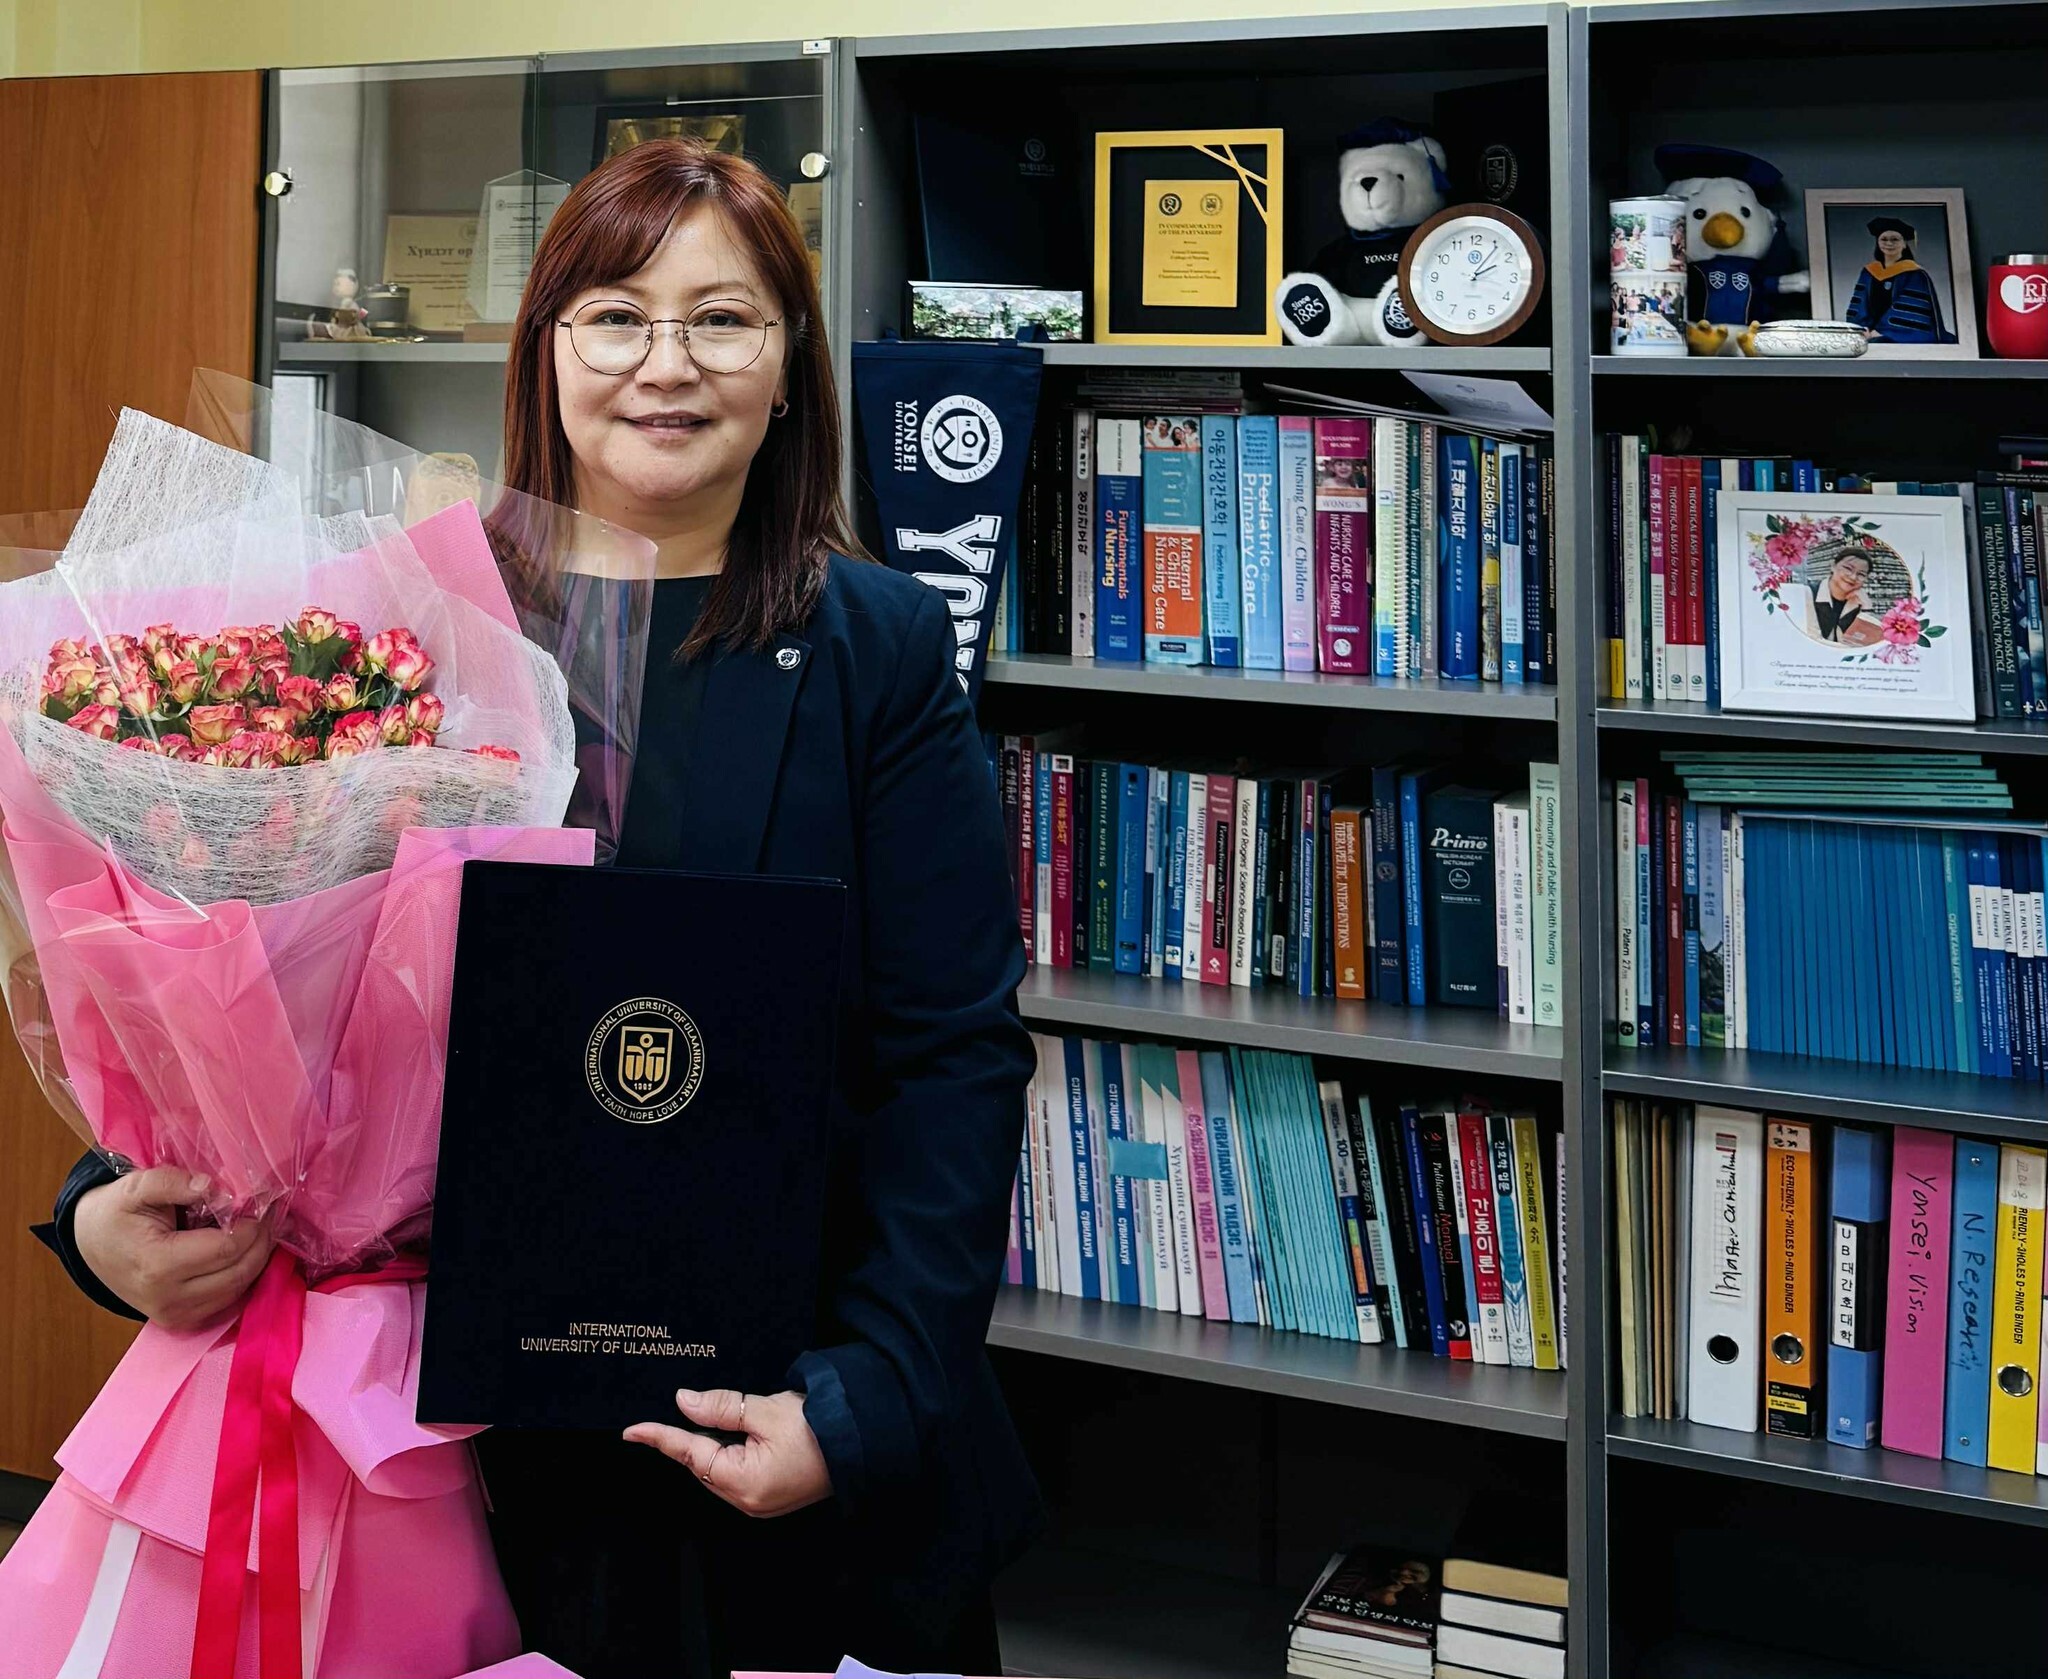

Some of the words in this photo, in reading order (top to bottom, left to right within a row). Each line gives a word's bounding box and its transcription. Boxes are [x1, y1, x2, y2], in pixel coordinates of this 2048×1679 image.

[1452, 240, 1462, 250] 11
[1470, 235, 1482, 246] 12
[1364, 253, 1398, 264] YONSE
[1438, 254, 1449, 265] 10
[1504, 253, 1512, 263] 2
[1430, 272, 1438, 282] 9
[1510, 274, 1518, 284] 3
[1291, 296, 1311, 311] Since
[1293, 298, 1324, 325] 1885
[1436, 291, 1444, 301] 8
[1450, 304, 1458, 314] 7
[1488, 305, 1495, 315] 5
[1503, 291, 1510, 301] 4
[1468, 310, 1476, 320] 6
[894, 401, 903, 472] UNIVERSITY
[904, 400, 918, 472] YONSEI
[1294, 456, 1308, 502] Nursing
[1105, 510, 1114, 524] of
[1242, 473, 1256, 560] Primary
[1258, 473, 1272, 567] Pediatric
[1295, 506, 1308, 534] Care
[1409, 488, 1419, 525] Writing
[1651, 474, 1662, 558] 간호연구방법
[1668, 486, 1677, 532] THEORETICAL
[1688, 486, 1696, 532] THEORETICAL
[1168, 537, 1180, 548] &
[1330, 514, 1340, 550] INFANTS
[1340, 514, 1352, 553] NURSING
[1670, 533, 1678, 554] BASIS
[1689, 533, 1697, 554] BASIS
[1994, 524, 2006, 557] HEALTH
[1102, 528, 1117, 586] Nursing
[1118, 510, 1129, 600] Fundamentals
[1152, 536, 1167, 594] Nursing
[1330, 552, 1340, 573] AND
[1410, 528, 1419, 574] Literature
[1670, 556, 1679, 568] for
[1690, 556, 1698, 568] for
[1984, 526, 1996, 578] PREVENTION
[2021, 525, 2036, 575] SOCIOLOGY
[1168, 551, 1180, 588] Child
[1182, 537, 1194, 601] Maternal
[1295, 547, 1308, 602] Children
[1341, 556, 1352, 578] CARE
[1668, 568, 1680, 597] Nursing
[1688, 568, 1698, 597] Nursing
[1244, 564, 1258, 615] Care
[1330, 574, 1340, 618] CHILDREN
[1342, 580, 1352, 593] OF
[1410, 578, 1420, 616] Reviews
[1988, 580, 1997, 590] IN
[1997, 560, 2008, 612] PROMOTION
[1155, 597, 1168, 630] Care
[1990, 592, 2002, 631] CLINICAL
[2000, 617, 2012, 638] AND
[1994, 633, 2006, 673] PRACTICE
[2004, 638, 2016, 674] DISEASE
[1100, 768, 1108, 824] INTEGRATIVE
[1242, 798, 1251, 826] Visions
[1188, 828, 1196, 848] FOR
[1197, 808, 1206, 842] MIDDLE
[1346, 822, 1354, 854] Handbook
[1546, 796, 1556, 848] Community
[1098, 828, 1107, 867] NURSING
[1176, 826, 1186, 852] Clinical
[1218, 825, 1228, 872] Perspectives
[1334, 822, 1347, 880] THERAPEUTIC
[1430, 827, 1488, 850] Prime
[1174, 854, 1184, 883] Decision
[1188, 850, 1196, 889] NURSING
[1196, 844, 1204, 876] RANGE
[1304, 838, 1313, 896] Communication
[1546, 850, 1556, 868] and
[1640, 854, 1648, 873] Critical
[1172, 884, 1182, 910] Making
[1194, 878, 1202, 914] THEORY
[1536, 873, 1544, 896] Health
[1548, 870, 1556, 896] Public
[1216, 884, 1226, 916] Nursing
[1237, 870, 1248, 934] Science-Based
[1336, 882, 1350, 948] INTERVENTIONS
[1548, 898, 1557, 928] Health
[1214, 916, 1224, 946] Theory
[1302, 907, 1311, 938] Nursing
[1976, 912, 1984, 937] Journal
[1992, 913, 2000, 938] Journal
[2002, 910, 2012, 946] JOURNAL
[2020, 916, 2029, 950] JOURNAL
[2034, 914, 2044, 949] JOURNAL
[1235, 936, 1246, 968] Nursing
[1546, 930, 1557, 965] Nursing
[1622, 928, 1632, 956] Pattern
[1380, 958, 1398, 967] 2025
[588, 1015, 618, 1092] INTERNATIONAL
[616, 1001, 674, 1018] UNIVERSITY
[673, 1012, 686, 1023] OF
[680, 1022, 702, 1098] ULAANBAATAR
[604, 1097, 627, 1116] FAITH
[630, 1110, 654, 1120] HOPE
[656, 1100, 679, 1117] LOVE
[1071, 1077, 1084, 1124] СЭТГЭЦИЙН
[1108, 1084, 1120, 1130] СЭТГЭЦИЙН
[1337, 1139, 1349, 1158] 100
[1078, 1162, 1090, 1202] МЭНДИЙН
[1470, 1168, 1478, 1191] Nursing
[1498, 1172, 1510, 1191] 입문
[1200, 1201, 1215, 1243] ҮНДЭС
[1224, 1204, 1242, 1246] ҮНДЭС
[1432, 1162, 1446, 1210] Publication
[1439, 1213, 1459, 1264] Manual
[1081, 1210, 1094, 1258] СУВИЛАХУЙ
[1117, 1217, 1130, 1264] СУВИЛАХУЙ
[1154, 1204, 1169, 1270] сувилахуй
[1176, 1210, 1193, 1275] сувилахуй
[1784, 1251, 1794, 1282] D-RING
[1784, 1282, 1794, 1314] BINDER
[1906, 1275, 1928, 1333] Vision
[2014, 1280, 2026, 1312] D-RING
[569, 1322, 672, 1338] INTERNATIONAL
[2014, 1314, 2024, 1344] BINDER
[521, 1338, 600, 1353] UNIVERSITY
[602, 1340, 620, 1354] OF
[624, 1341, 716, 1358] ULAANBAATAR
